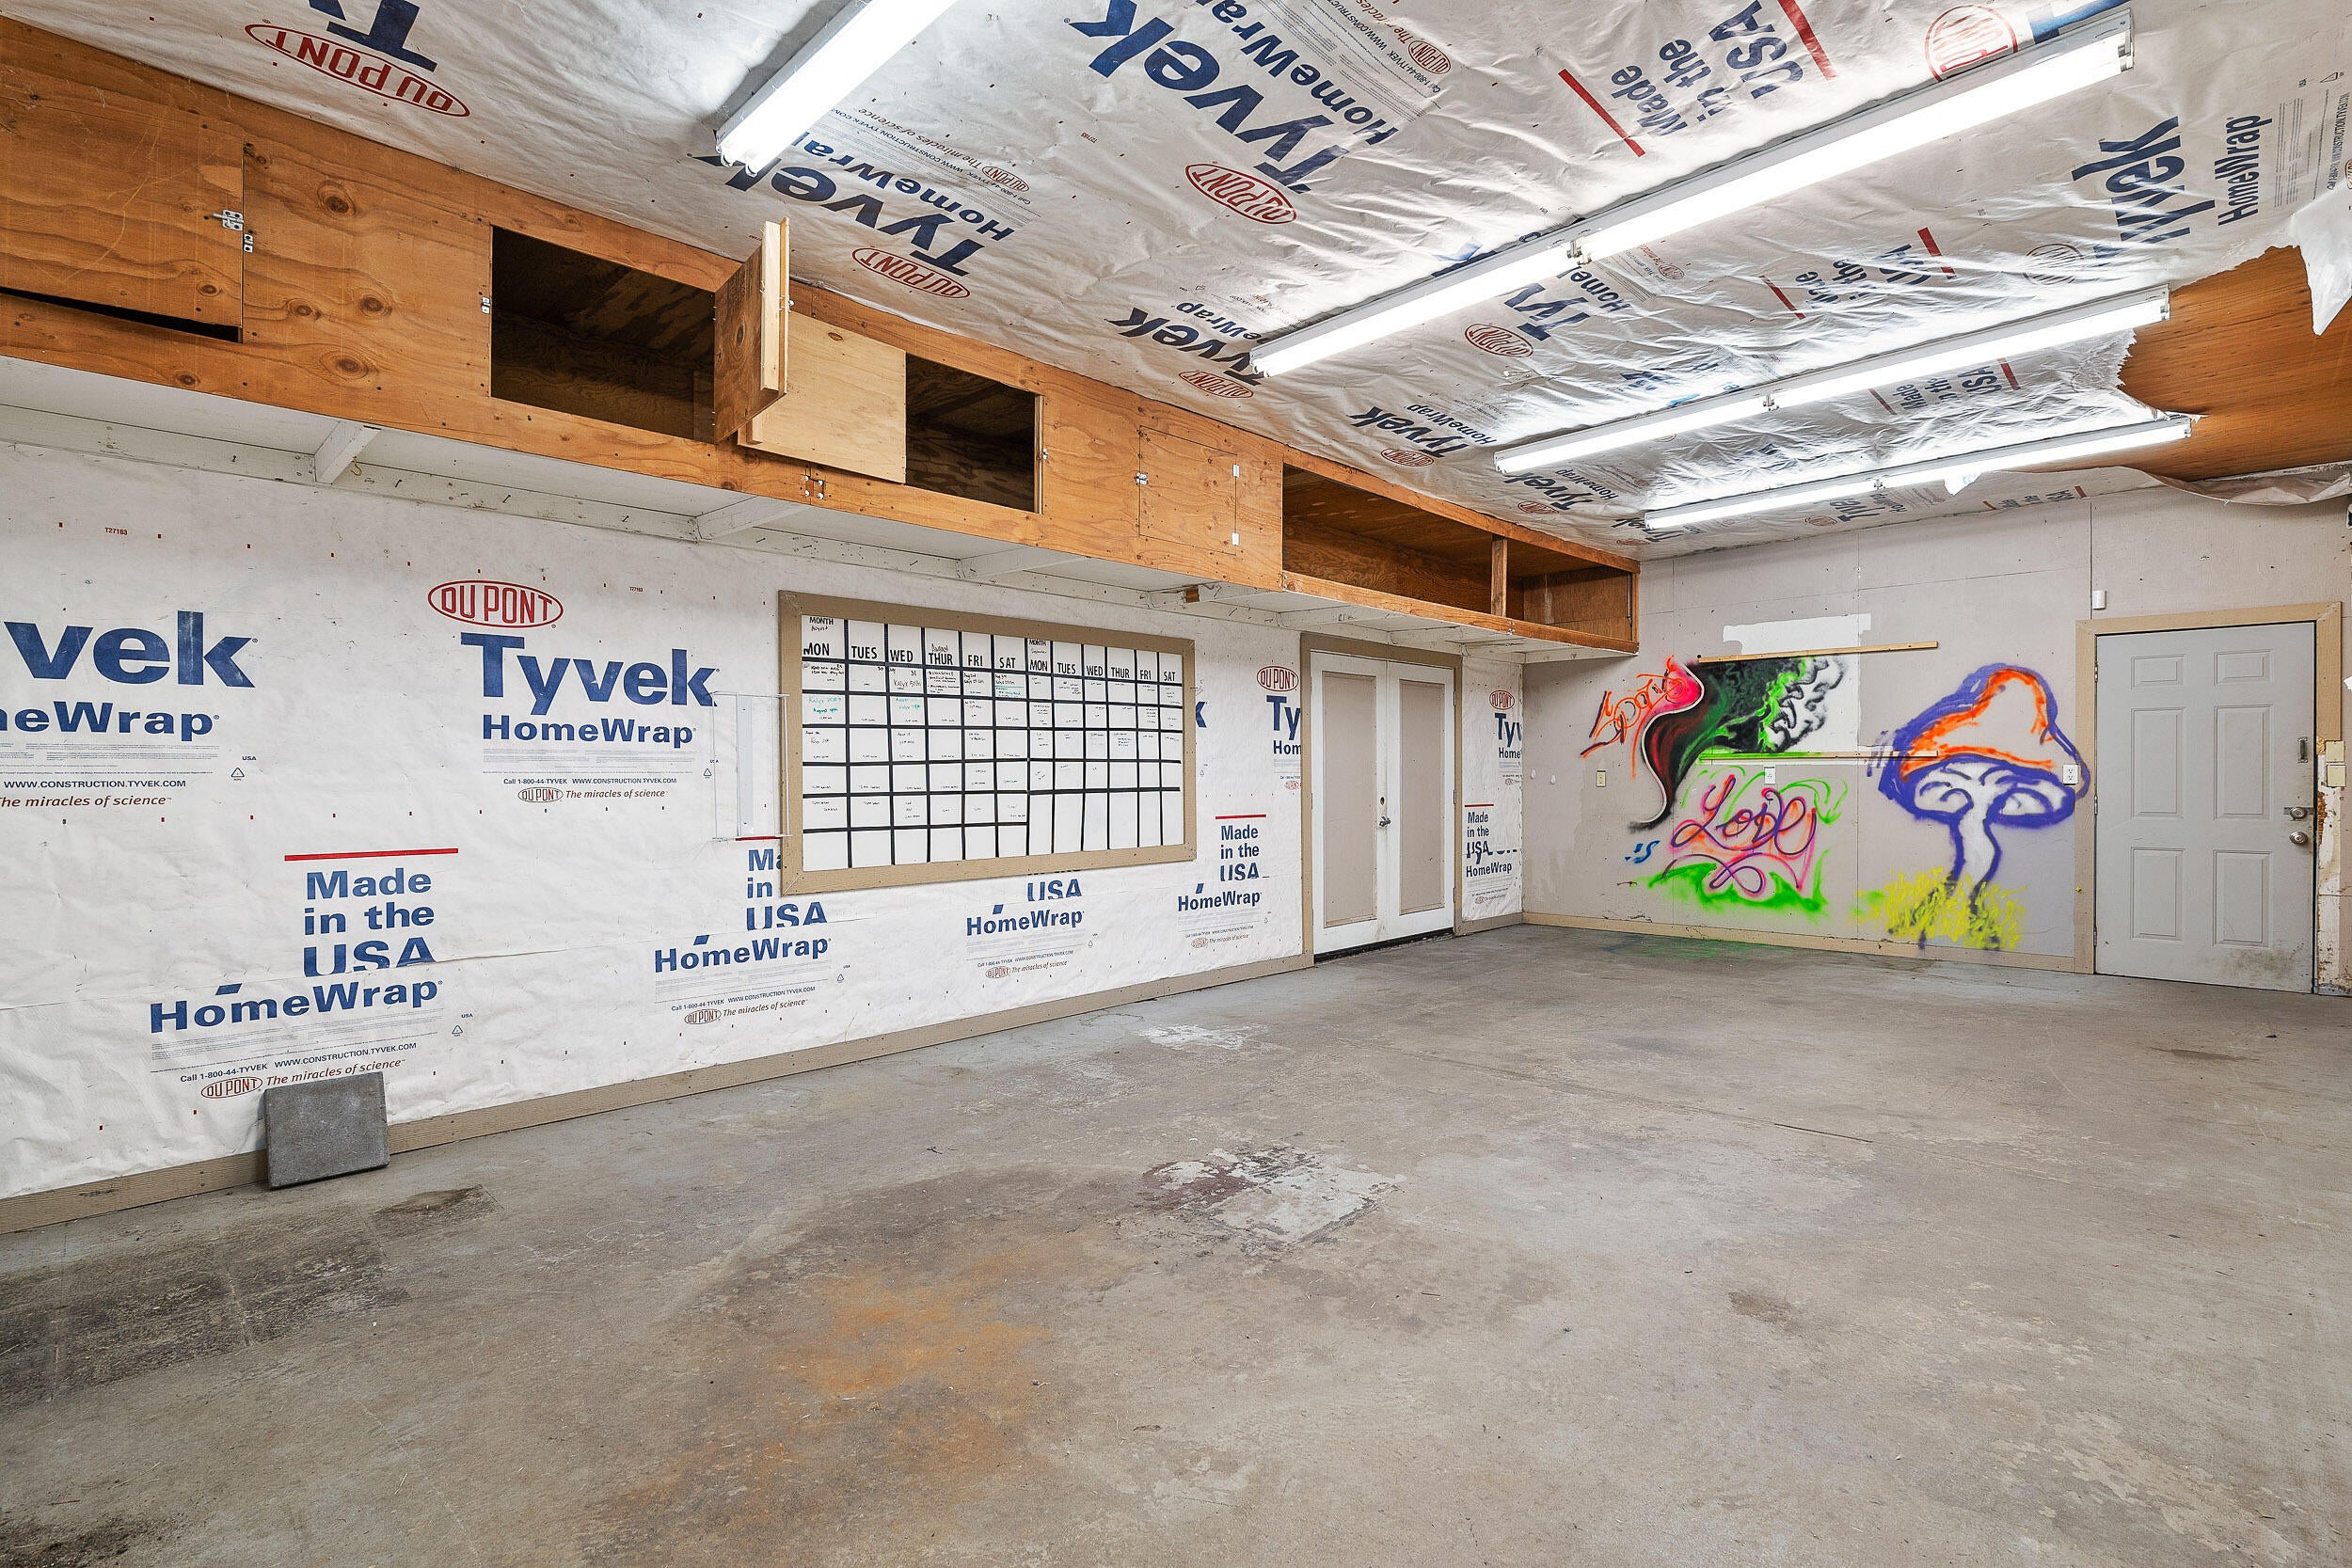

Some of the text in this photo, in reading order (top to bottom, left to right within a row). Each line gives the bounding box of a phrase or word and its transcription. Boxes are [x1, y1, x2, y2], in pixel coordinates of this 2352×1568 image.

[1708, 0, 1804, 99] USA
[1196, 0, 1399, 145] HomeWra
[1659, 39, 1730, 122] in the
[1069, 0, 1350, 194] Tyvek
[1611, 65, 1688, 136] Made
[858, 109, 901, 129] science
[916, 135, 962, 160] miracles
[962, 156, 983, 169] The
[2215, 114, 2273, 227] HomeWrap
[791, 132, 1015, 242] HomeWra
[691, 155, 985, 277] Tyvek
[1557, 266, 1630, 313] Home
[1347, 405, 1470, 458] Tyvek
[1406, 404, 1498, 446] HomeWrap
[809, 616, 834, 626] MONTH
[4, 610, 255, 688] vek
[803, 642, 1176, 682] MON TUES WED THUR FRI SAT MON TUES WED THUR FRI SAT
[461, 632, 718, 715] Tyvek
[483, 715, 693, 749] HomeWrap
[1498, 747, 1521, 758] Home
[4, 780, 186, 788] WWW.CONSTRUCTION.TYVEK.COM
[565, 789, 582, 799] The
[584, 789, 623, 798] miracles
[624, 789, 633, 800] of
[634, 788, 665, 798] science
[25, 796, 90, 807] miracles
[94, 795, 111, 808] of
[113, 795, 167, 805] science
[1467, 826, 1489, 838] in the
[1468, 812, 1489, 824] Made
[1221, 825, 1259, 840] Made
[1220, 843, 1260, 859] in the
[1467, 840, 1490, 855] USA
[307, 867, 432, 900] Made
[1220, 863, 1260, 881] USA
[1466, 862, 1513, 878] HomeWrap
[747, 878, 772, 898] in
[1027, 879, 1082, 901] USA
[1178, 891, 1262, 911] HomeWrap
[305, 902, 435, 935] in the
[746, 902, 827, 930] USA
[966, 910, 1082, 936] HomeWrap
[304, 937, 437, 977] USA
[655, 937, 829, 974] HomeWrap
[151, 981, 438, 1034] HomeWrap
[738, 1004, 770, 1015] miracles
[771, 1002, 779, 1010] of
[780, 999, 806, 1008] science
[181, 1042, 417, 1083] Call 1-800-44-TYVEK WWW.CONSTRUCTION.TYVEK.COM
[266, 1075, 289, 1086] The
[292, 1069, 342, 1085] miracles
[345, 1064, 359, 1078] of
[360, 1061, 402, 1074] science
